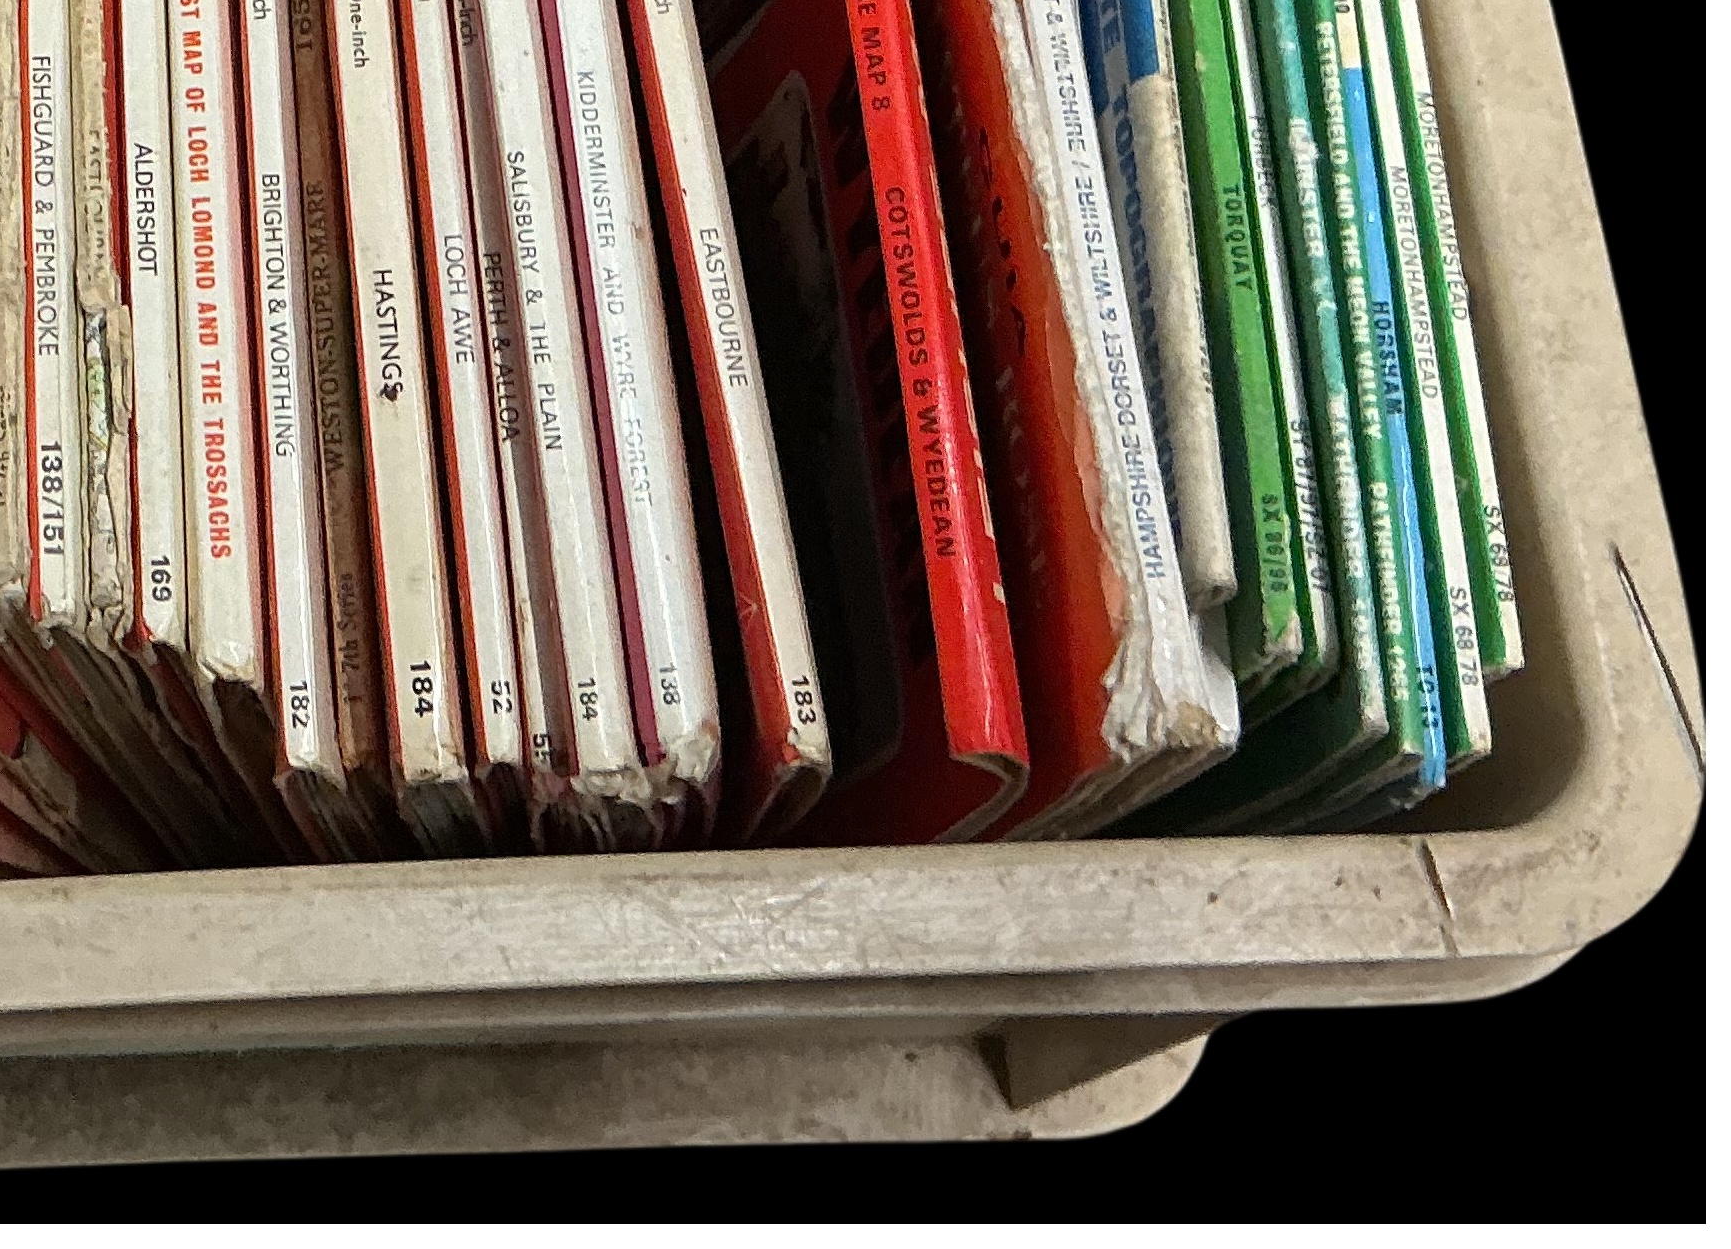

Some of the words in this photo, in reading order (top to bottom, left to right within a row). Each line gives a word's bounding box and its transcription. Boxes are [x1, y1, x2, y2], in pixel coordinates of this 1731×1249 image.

[182, 31, 202, 76] MAP
[862, 27, 888, 86] MAP
[30, 56, 54, 186] FISHGUARD
[185, 87, 205, 113] OF
[872, 96, 890, 110] 8
[188, 126, 208, 183] LOCH
[35, 202, 52, 215] &
[134, 143, 158, 276] ALDERSHOT
[262, 173, 285, 291] BRIGHTON
[506, 151, 535, 276] SALISBURY
[1224, 186, 1253, 293] TORQUAY
[191, 196, 215, 291] LOMOND
[35, 225, 58, 356] PEMBROKE
[268, 299, 285, 312] &
[525, 290, 540, 306] &
[700, 229, 748, 387] EASTBOURNE
[885, 188, 928, 367] COTSWOLDS
[1388, 167, 1438, 400] MORETONHAMPSTEAD
[198, 301, 219, 347] AND
[530, 321, 551, 365] THE
[200, 361, 221, 405] THE
[912, 378, 933, 398] &
[1101, 331, 1137, 425] DORSET
[1372, 300, 1403, 416] HORSHAM
[269, 326, 295, 459] WORTHING
[538, 383, 562, 452] PLAIN
[40, 442, 65, 553] 138/151
[202, 419, 232, 559] TROSSACHS
[917, 405, 956, 558] WYEDEAN
[150, 555, 171, 601] 169
[288, 681, 310, 729] 182
[409, 660, 434, 716] 184
[578, 679, 598, 721] 184
[791, 675, 816, 725] 183
